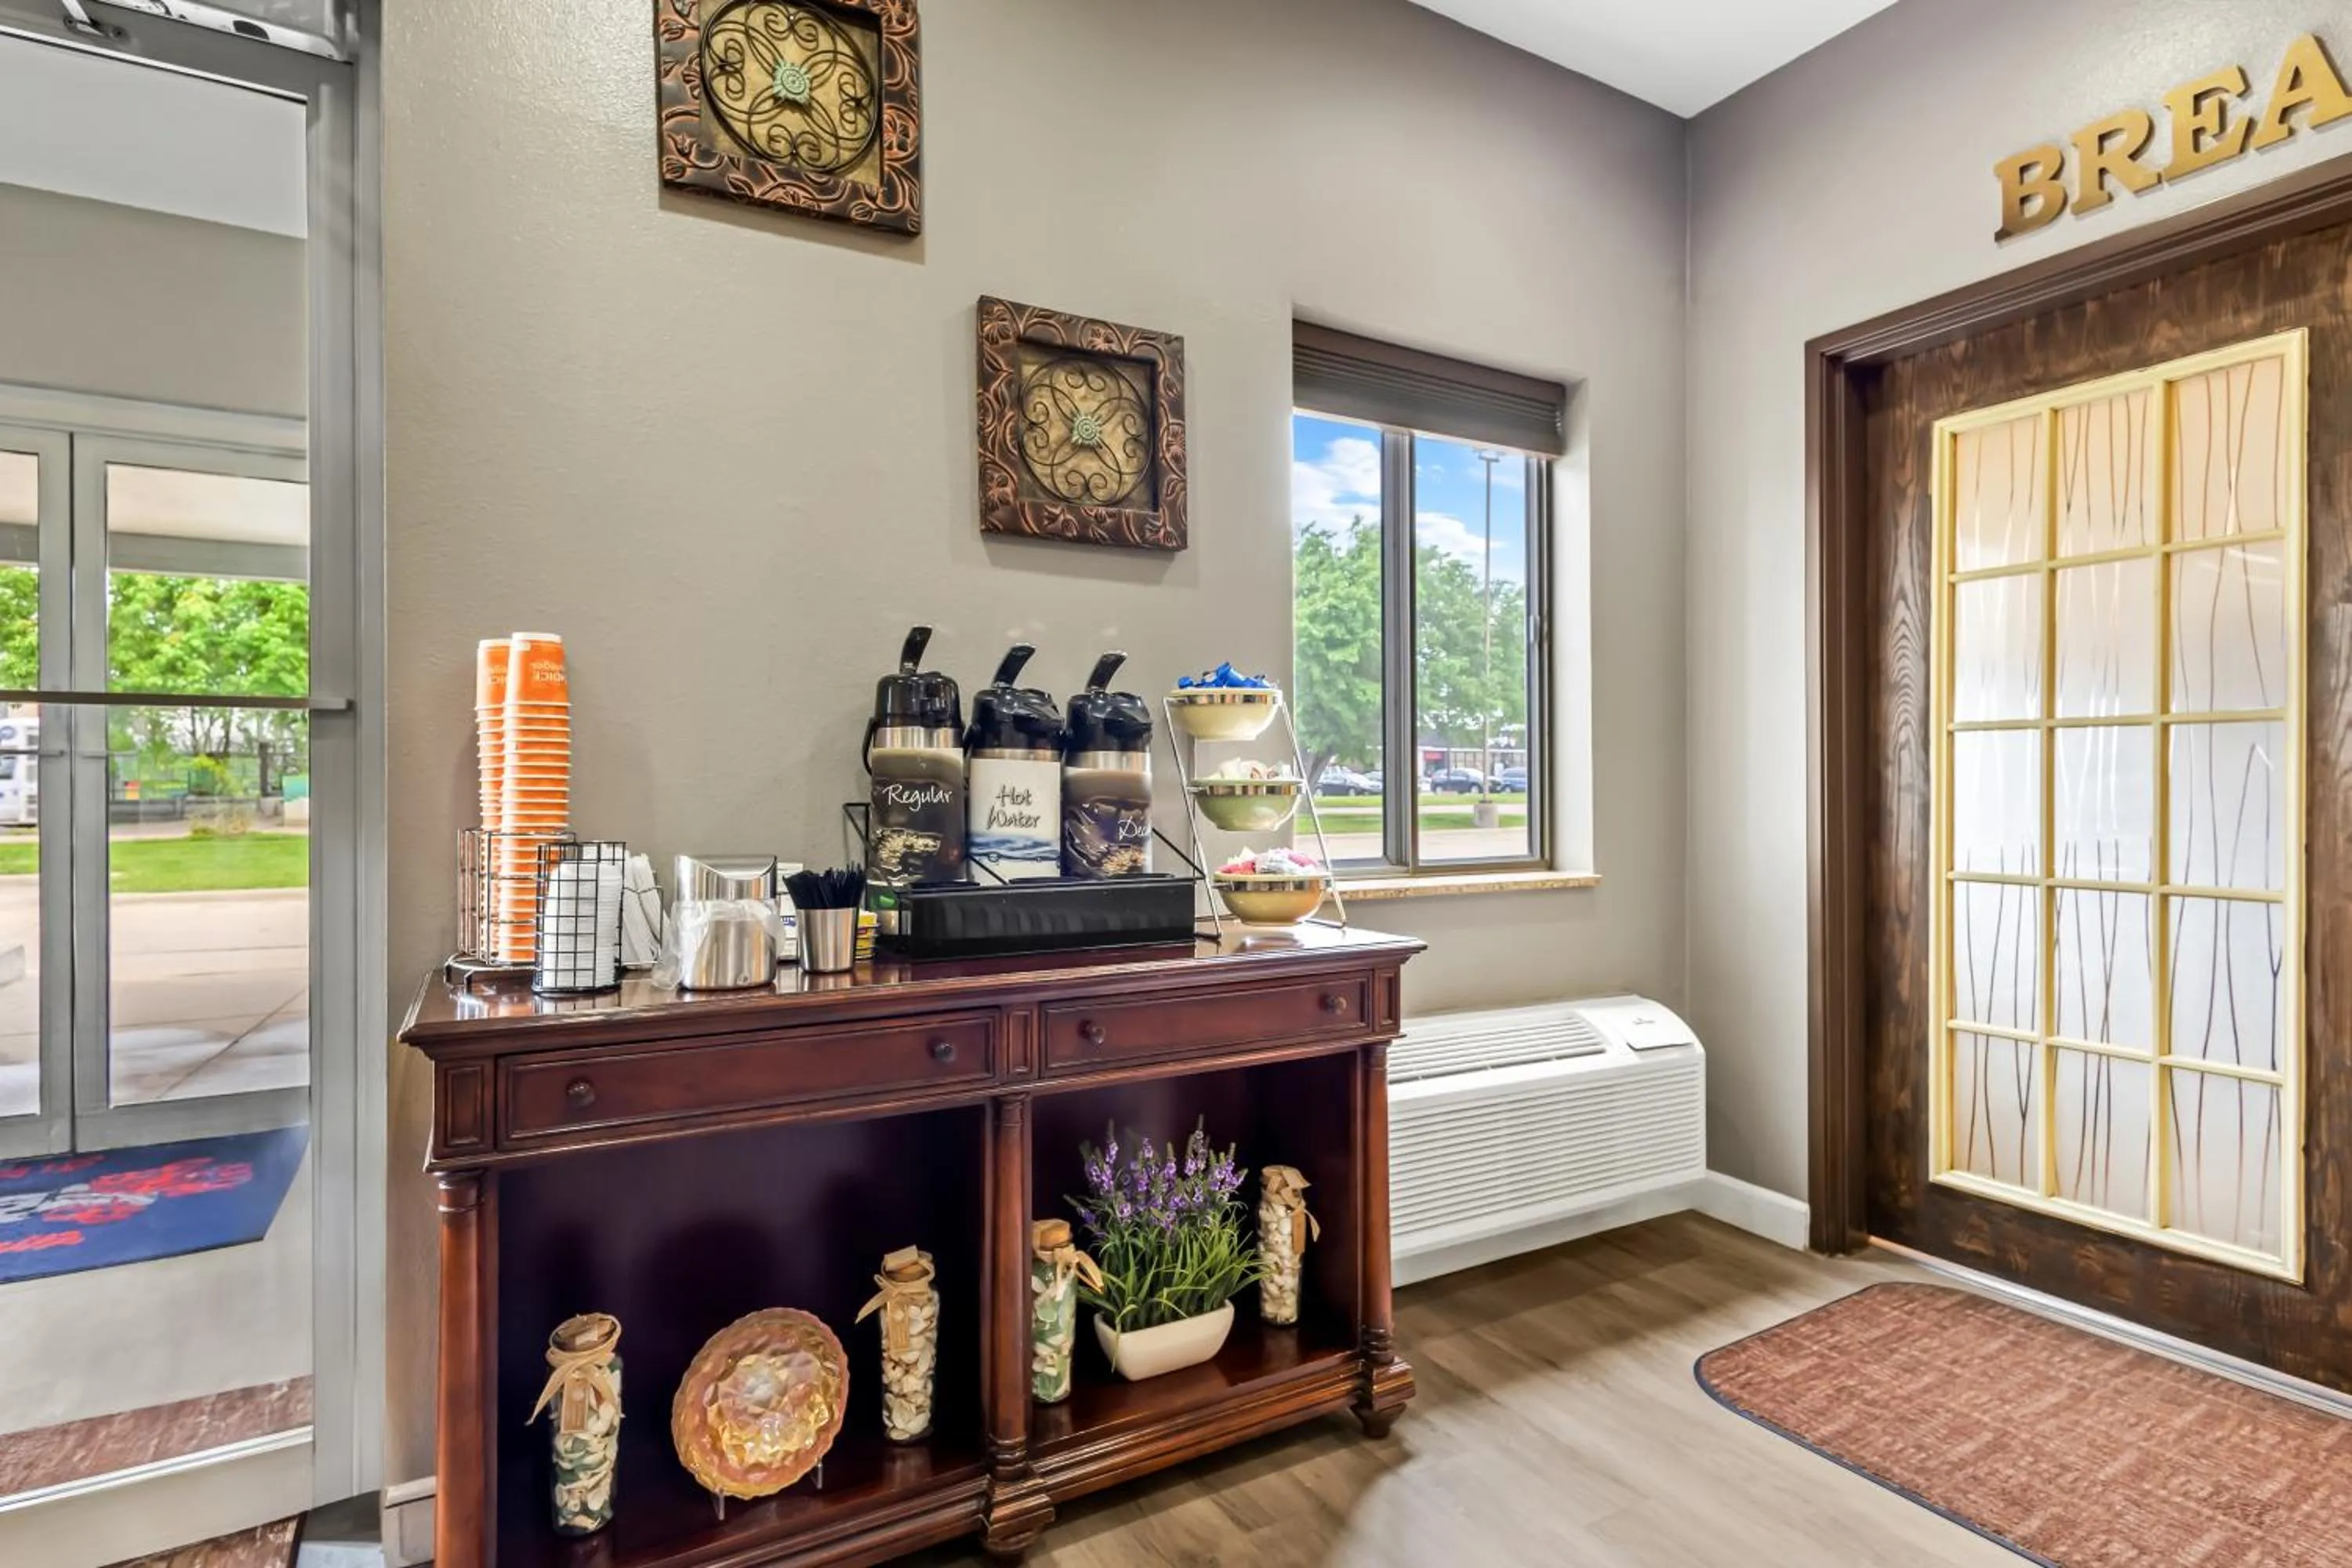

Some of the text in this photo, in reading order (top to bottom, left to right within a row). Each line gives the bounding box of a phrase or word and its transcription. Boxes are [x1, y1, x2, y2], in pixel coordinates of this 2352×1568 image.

[1993, 32, 2352, 243] BREA
[882, 784, 953, 812] Regular
[995, 784, 1033, 807] Hot
[986, 805, 1041, 829] Water
